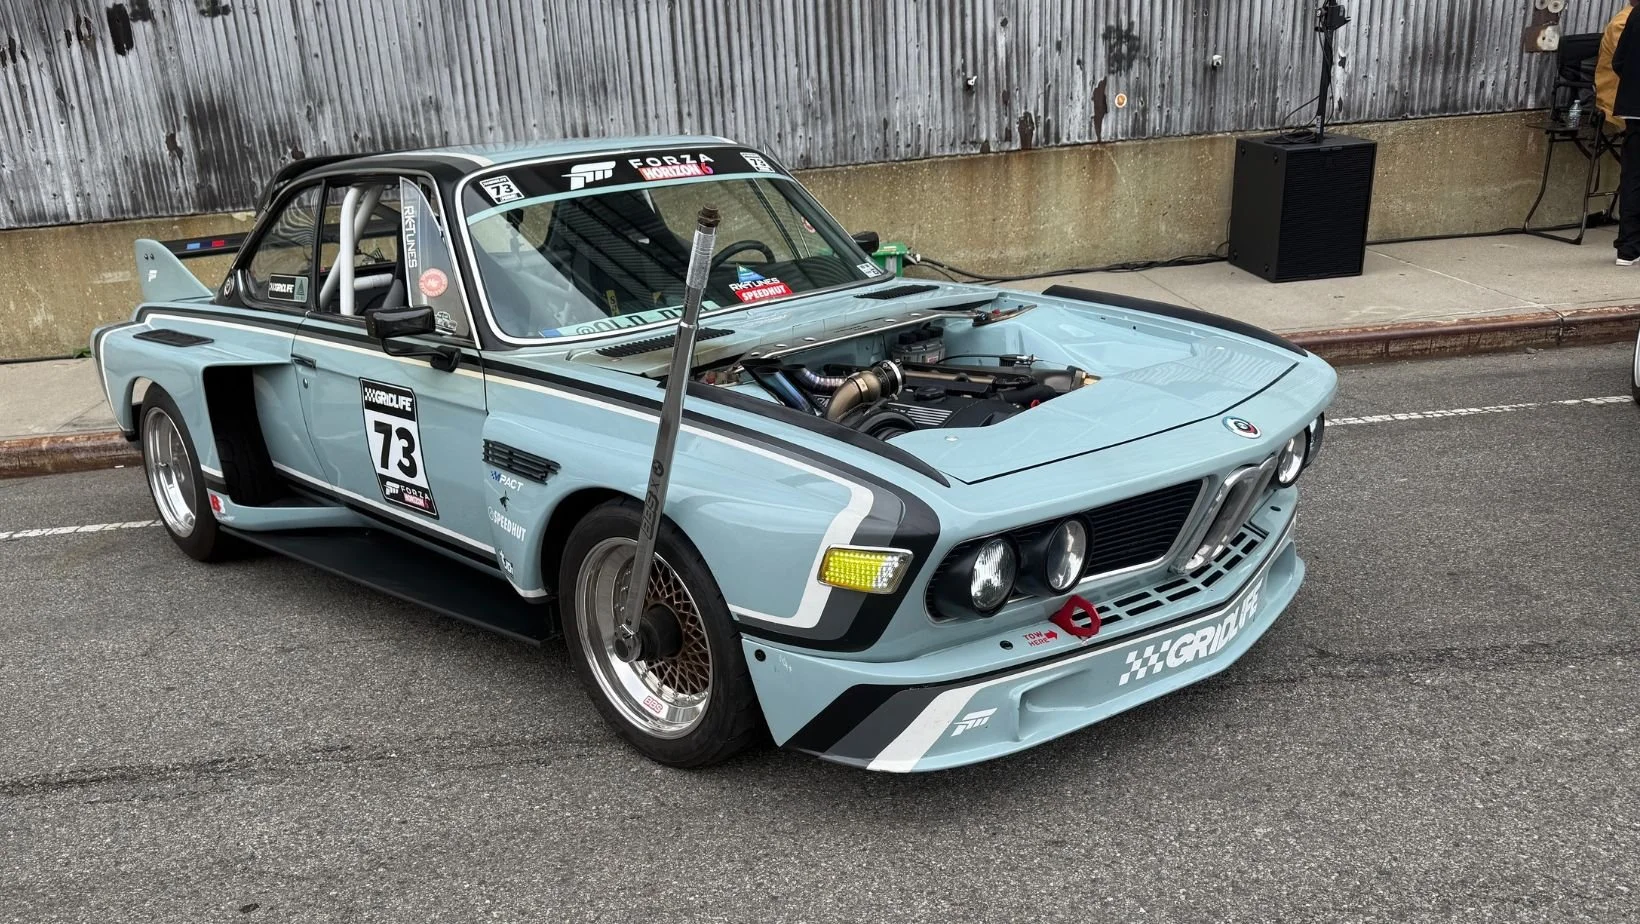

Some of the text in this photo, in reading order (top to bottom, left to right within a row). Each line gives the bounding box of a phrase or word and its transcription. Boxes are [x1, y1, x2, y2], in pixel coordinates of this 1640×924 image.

[628, 153, 714, 168] FORZA
[641, 163, 700, 180] HORIZON
[491, 183, 514, 196] 73
[741, 284, 787, 301] SPEEDHUT
[375, 390, 413, 412] GRIDLIFE
[374, 420, 418, 478] 73
[401, 485, 430, 501] FORZA
[640, 491, 660, 540] BBS
[494, 510, 527, 541] SPEEDHUT
[1165, 577, 1264, 668] GRIDLIFE
[1023, 631, 1043, 640] TOW
[1028, 637, 1050, 647] HERE
[643, 696, 663, 713] BBS
